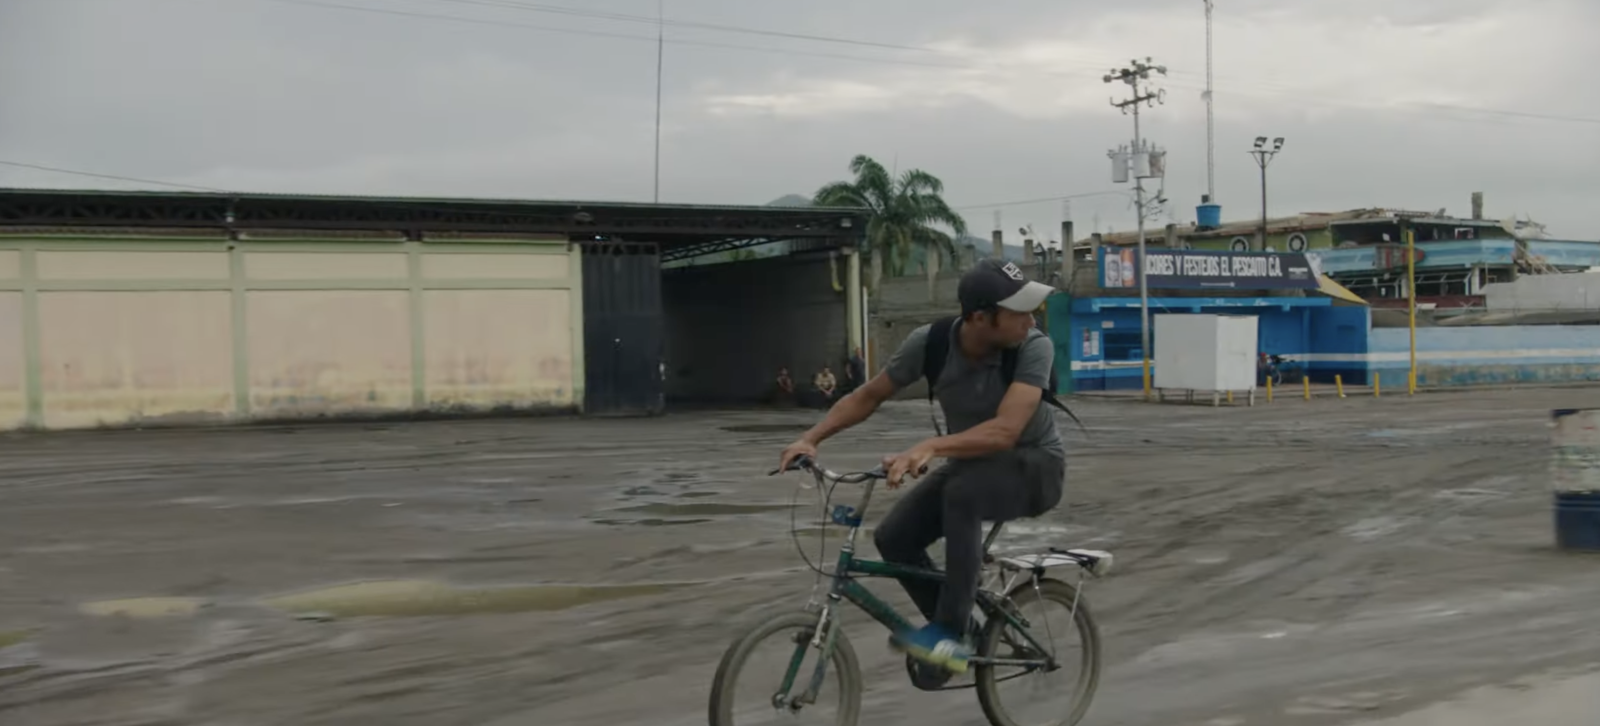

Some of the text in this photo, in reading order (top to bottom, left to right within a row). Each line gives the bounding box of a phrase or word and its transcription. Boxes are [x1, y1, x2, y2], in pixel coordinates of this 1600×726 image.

[1175, 255, 1182, 275] Y
[1183, 255, 1219, 276] FESTEJOS
[1221, 256, 1231, 276] EL
[1232, 256, 1267, 277] PESCAITO
